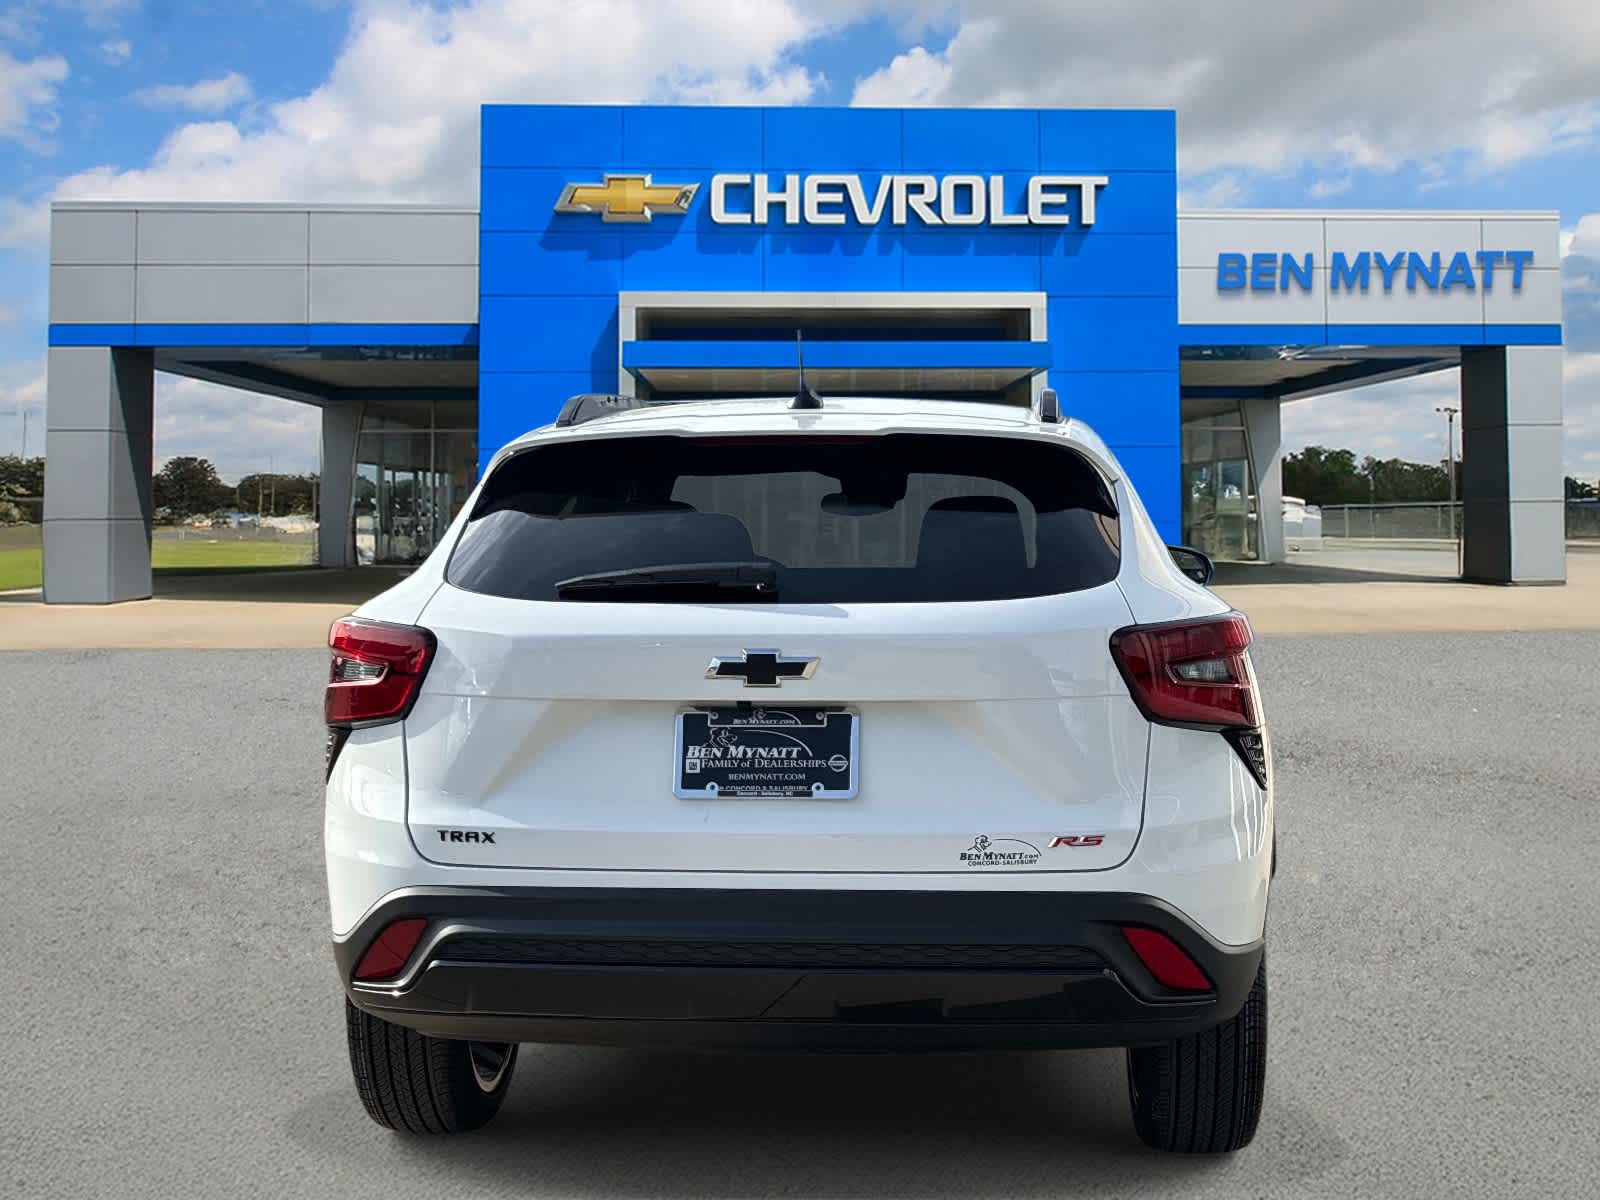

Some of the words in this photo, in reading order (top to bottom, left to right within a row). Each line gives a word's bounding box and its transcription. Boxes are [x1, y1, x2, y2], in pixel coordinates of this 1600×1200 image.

[711, 173, 1109, 226] CHEVROLET
[1217, 252, 1313, 290] BEN
[1330, 250, 1534, 290] MYNATT
[686, 745, 722, 759] BEN
[725, 745, 801, 759] MYNATT
[702, 759, 739, 769] FAMILY
[740, 759, 751, 769] of
[755, 758, 828, 769] DEALERSHIPS
[728, 773, 806, 781] BENMYNATT.COM
[437, 830, 496, 844] TRAX
[1048, 835, 1106, 848] RS
[960, 852, 981, 861] BEN
[967, 859, 1038, 867] CONCORD-SALISBURY
